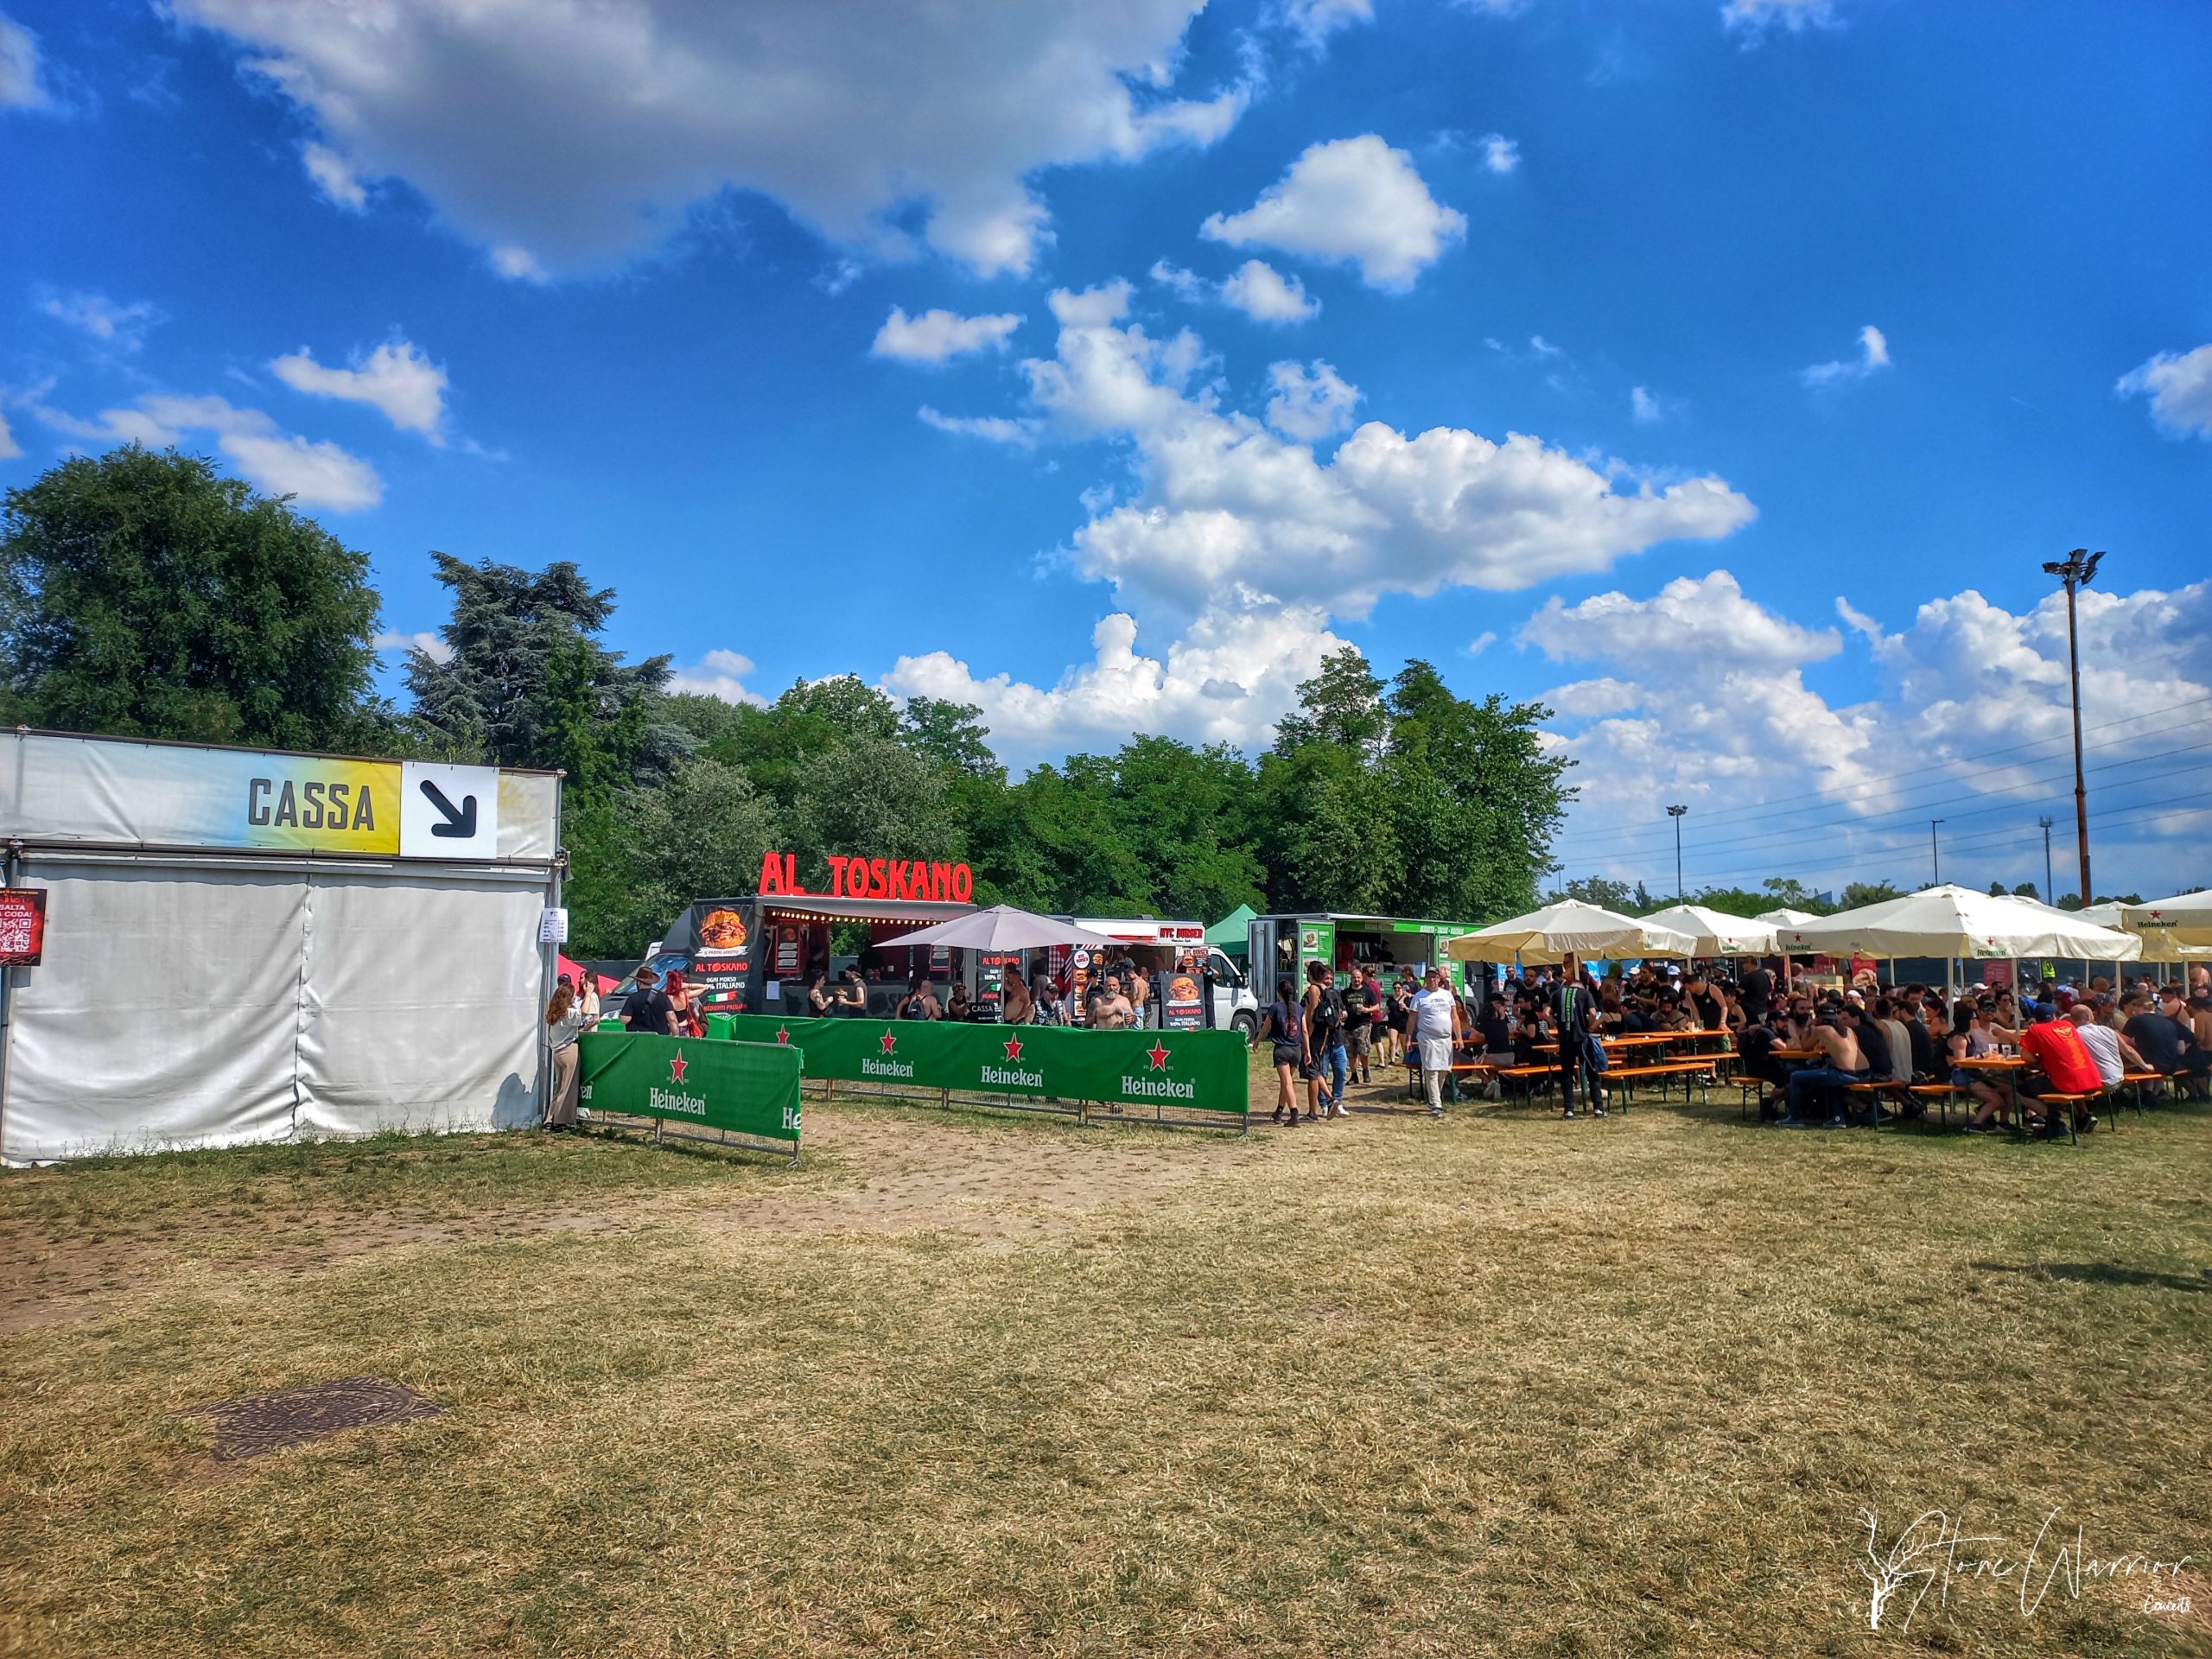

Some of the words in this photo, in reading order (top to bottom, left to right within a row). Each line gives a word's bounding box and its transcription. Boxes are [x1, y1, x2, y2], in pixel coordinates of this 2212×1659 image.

[248, 778, 374, 830] CASSA
[759, 853, 805, 895] AL
[828, 856, 973, 901] TOSKANO
[1160, 928, 1174, 938] NYC
[1176, 928, 1203, 938] BURGER
[708, 963, 747, 972] TOSKANO
[861, 1058, 913, 1077] Heineken
[981, 1065, 1042, 1087] Heineken
[1122, 1076, 1194, 1098] Heineken
[650, 1087, 705, 1115] Heineken
